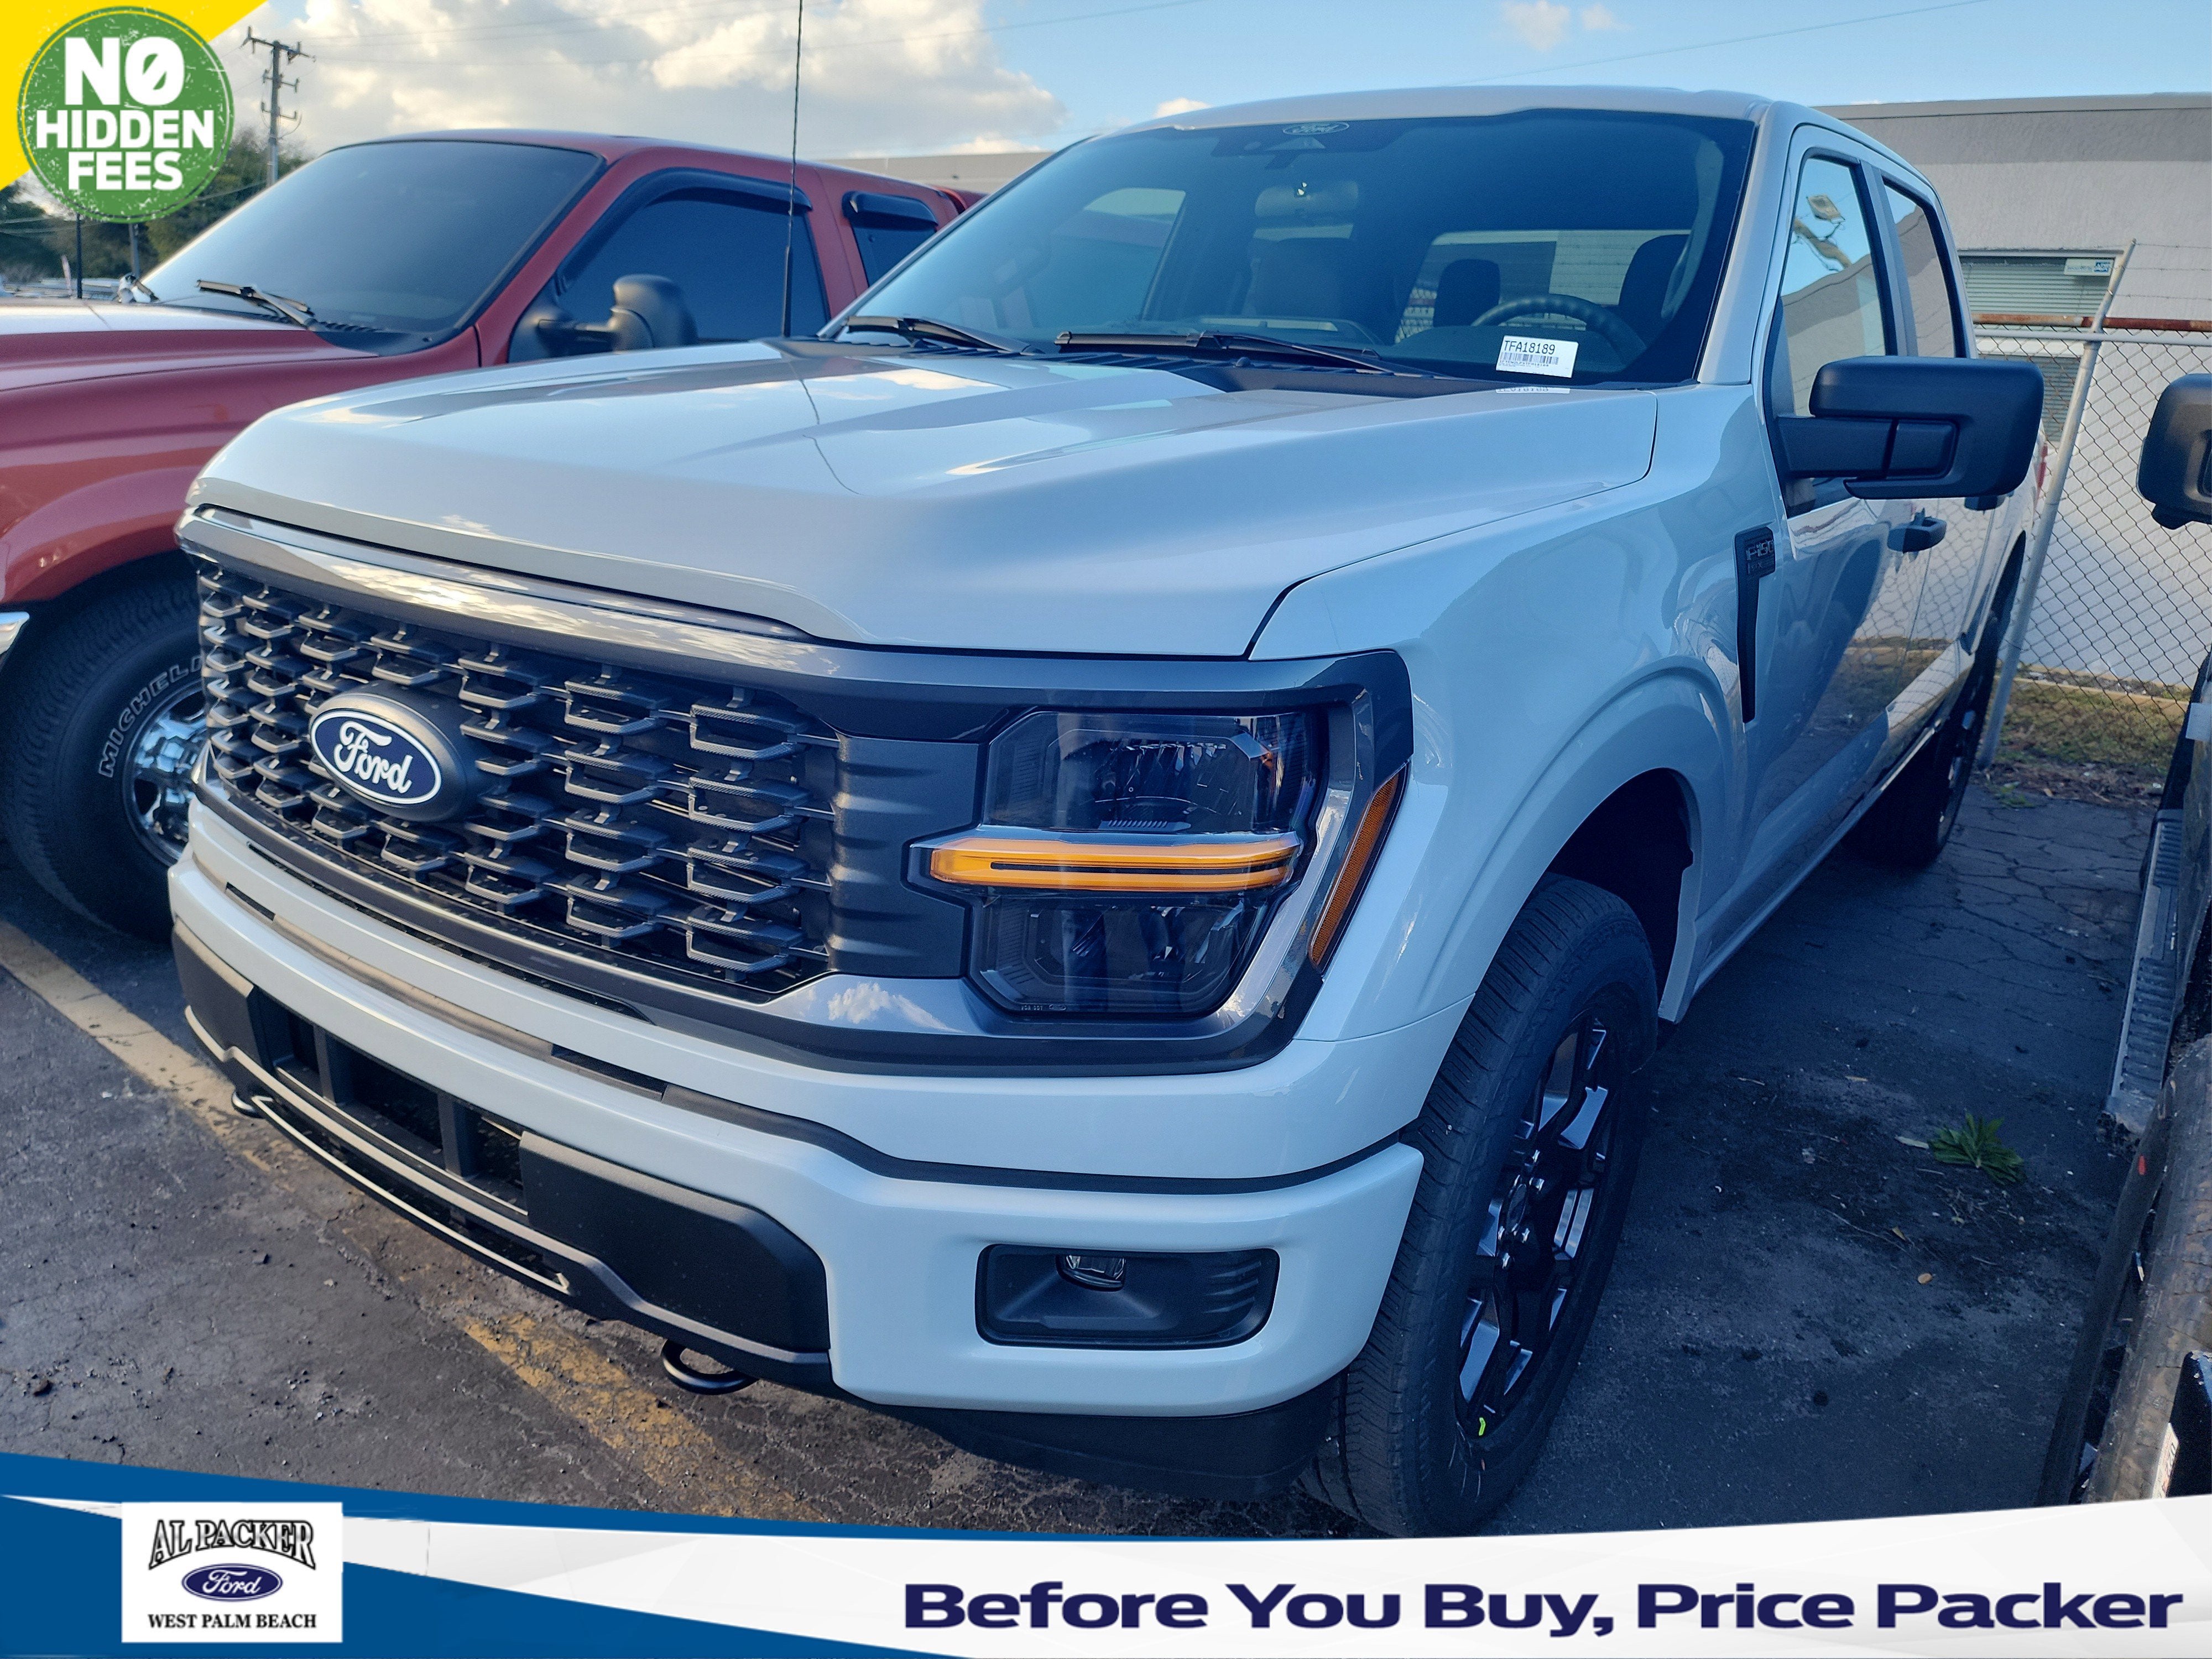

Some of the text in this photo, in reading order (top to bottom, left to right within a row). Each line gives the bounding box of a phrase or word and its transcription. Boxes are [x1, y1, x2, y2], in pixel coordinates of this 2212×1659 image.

[1504, 340, 1555, 355] TFA18189
[98, 655, 202, 778] MICHELI
[333, 720, 414, 794] Ford
